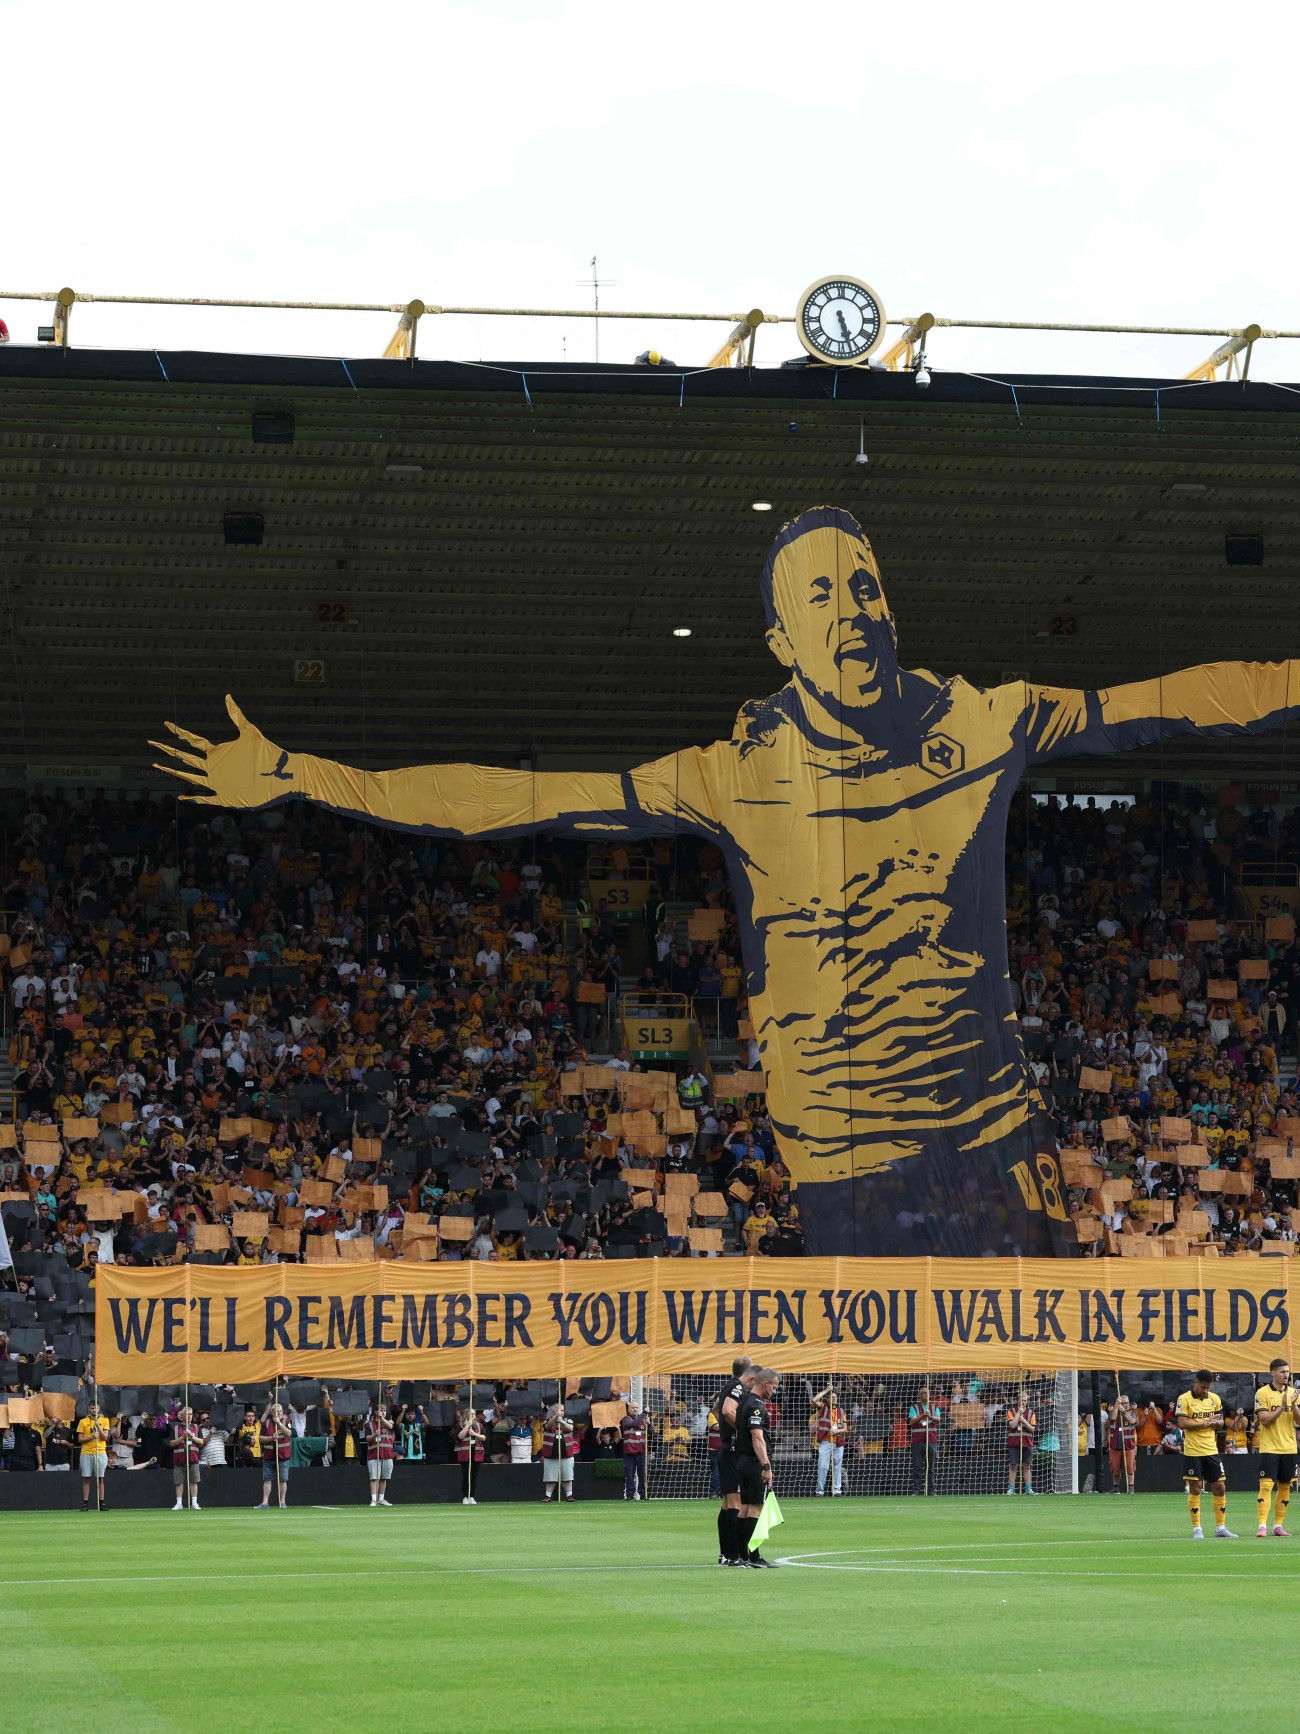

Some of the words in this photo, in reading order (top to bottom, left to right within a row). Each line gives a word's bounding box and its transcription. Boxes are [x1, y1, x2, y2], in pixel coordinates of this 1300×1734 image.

[319, 603, 346, 621] 22
[1052, 616, 1076, 635] 23
[297, 661, 322, 681] 22
[607, 888, 630, 905] S3
[1260, 894, 1281, 910] S4
[638, 1027, 673, 1045] SL3
[1007, 1153, 1072, 1222] 18
[107, 1296, 249, 1353] WE'LL
[263, 1291, 533, 1352] REMEMBER
[547, 1290, 648, 1347] YOU
[662, 1289, 807, 1345] WHEN
[817, 1289, 918, 1344] YOU
[931, 1289, 1066, 1344] WALK
[1079, 1289, 1125, 1343] IN
[1136, 1288, 1290, 1343] FIELDS
